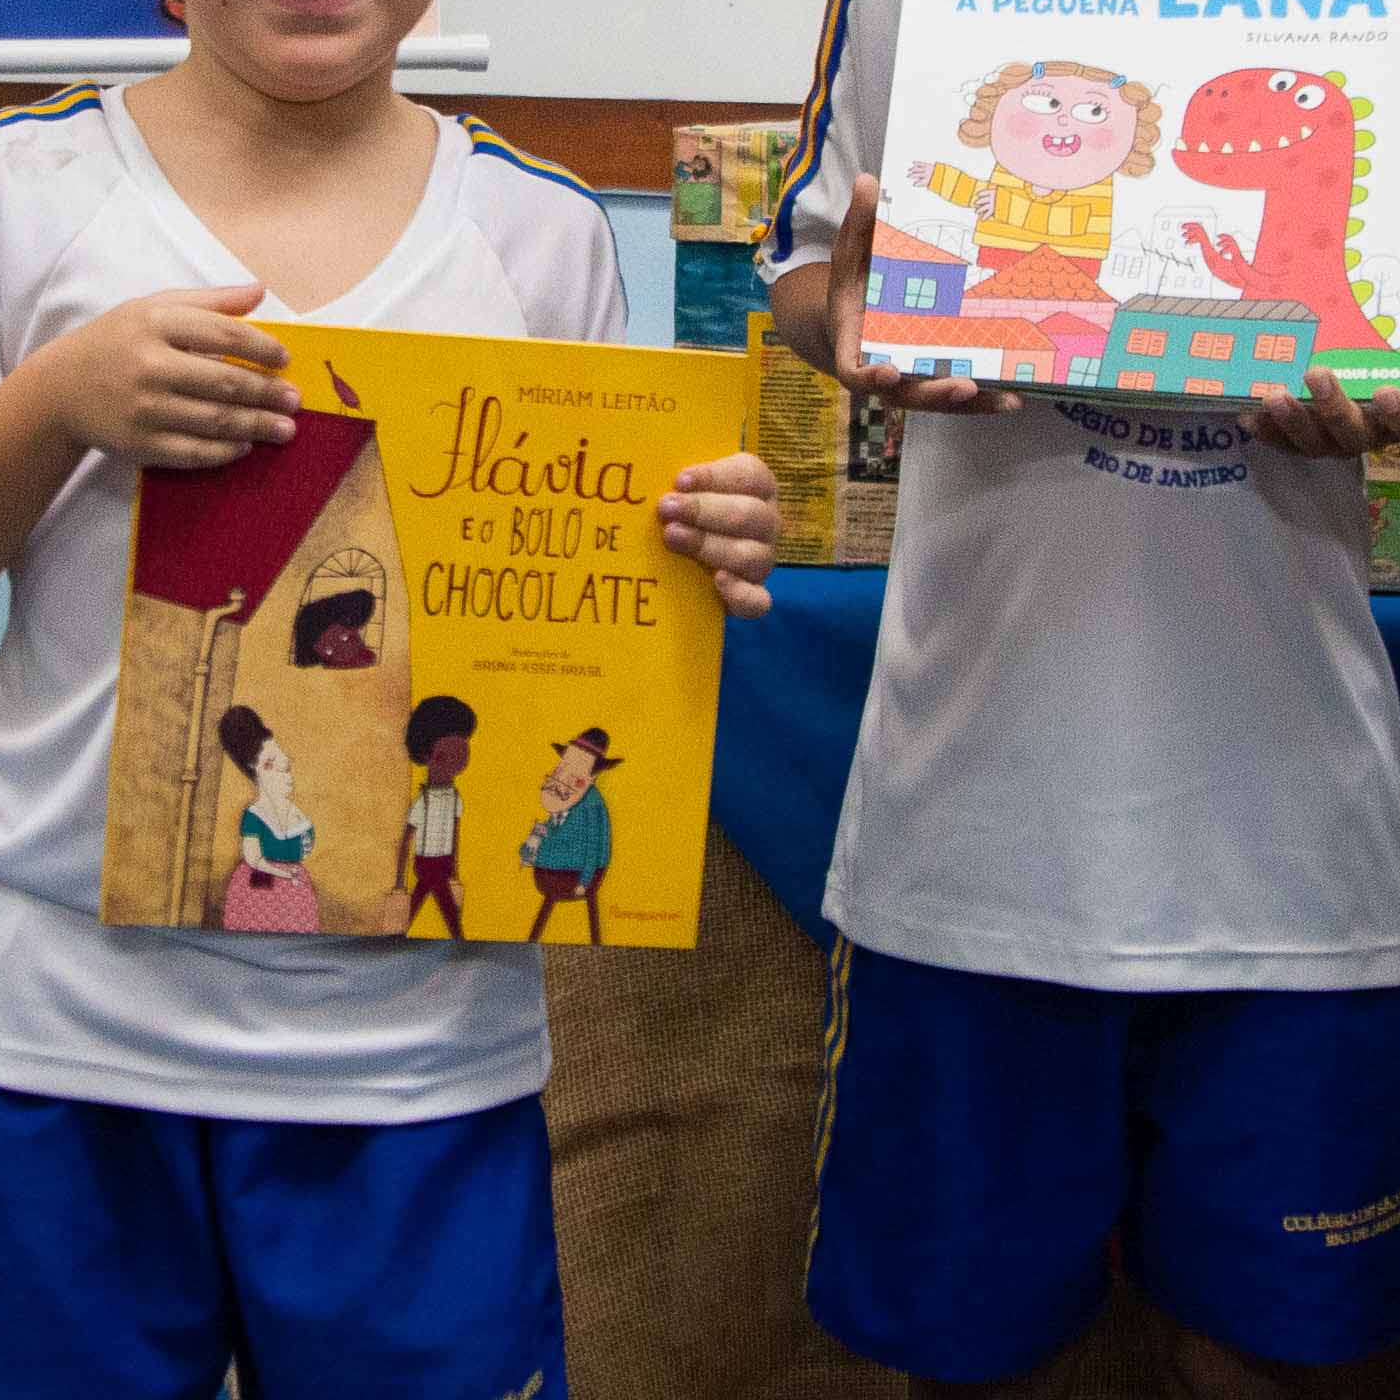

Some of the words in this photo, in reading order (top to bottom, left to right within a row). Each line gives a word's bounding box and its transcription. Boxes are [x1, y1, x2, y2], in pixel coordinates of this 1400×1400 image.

[1245, 32, 1321, 44] SILVANA
[1329, 31, 1389, 43] RANDO
[602, 392, 677, 413] LEITÃO
[409, 386, 647, 504] Flávia
[1084, 446, 1119, 472] RIO
[1123, 461, 1153, 483] DE
[1157, 463, 1248, 488] JANEIRO
[462, 517, 474, 541] E
[481, 519, 493, 543] O
[510, 506, 583, 559] BOLO
[596, 525, 620, 551] DE
[424, 561, 658, 627] CHOCOLATE
